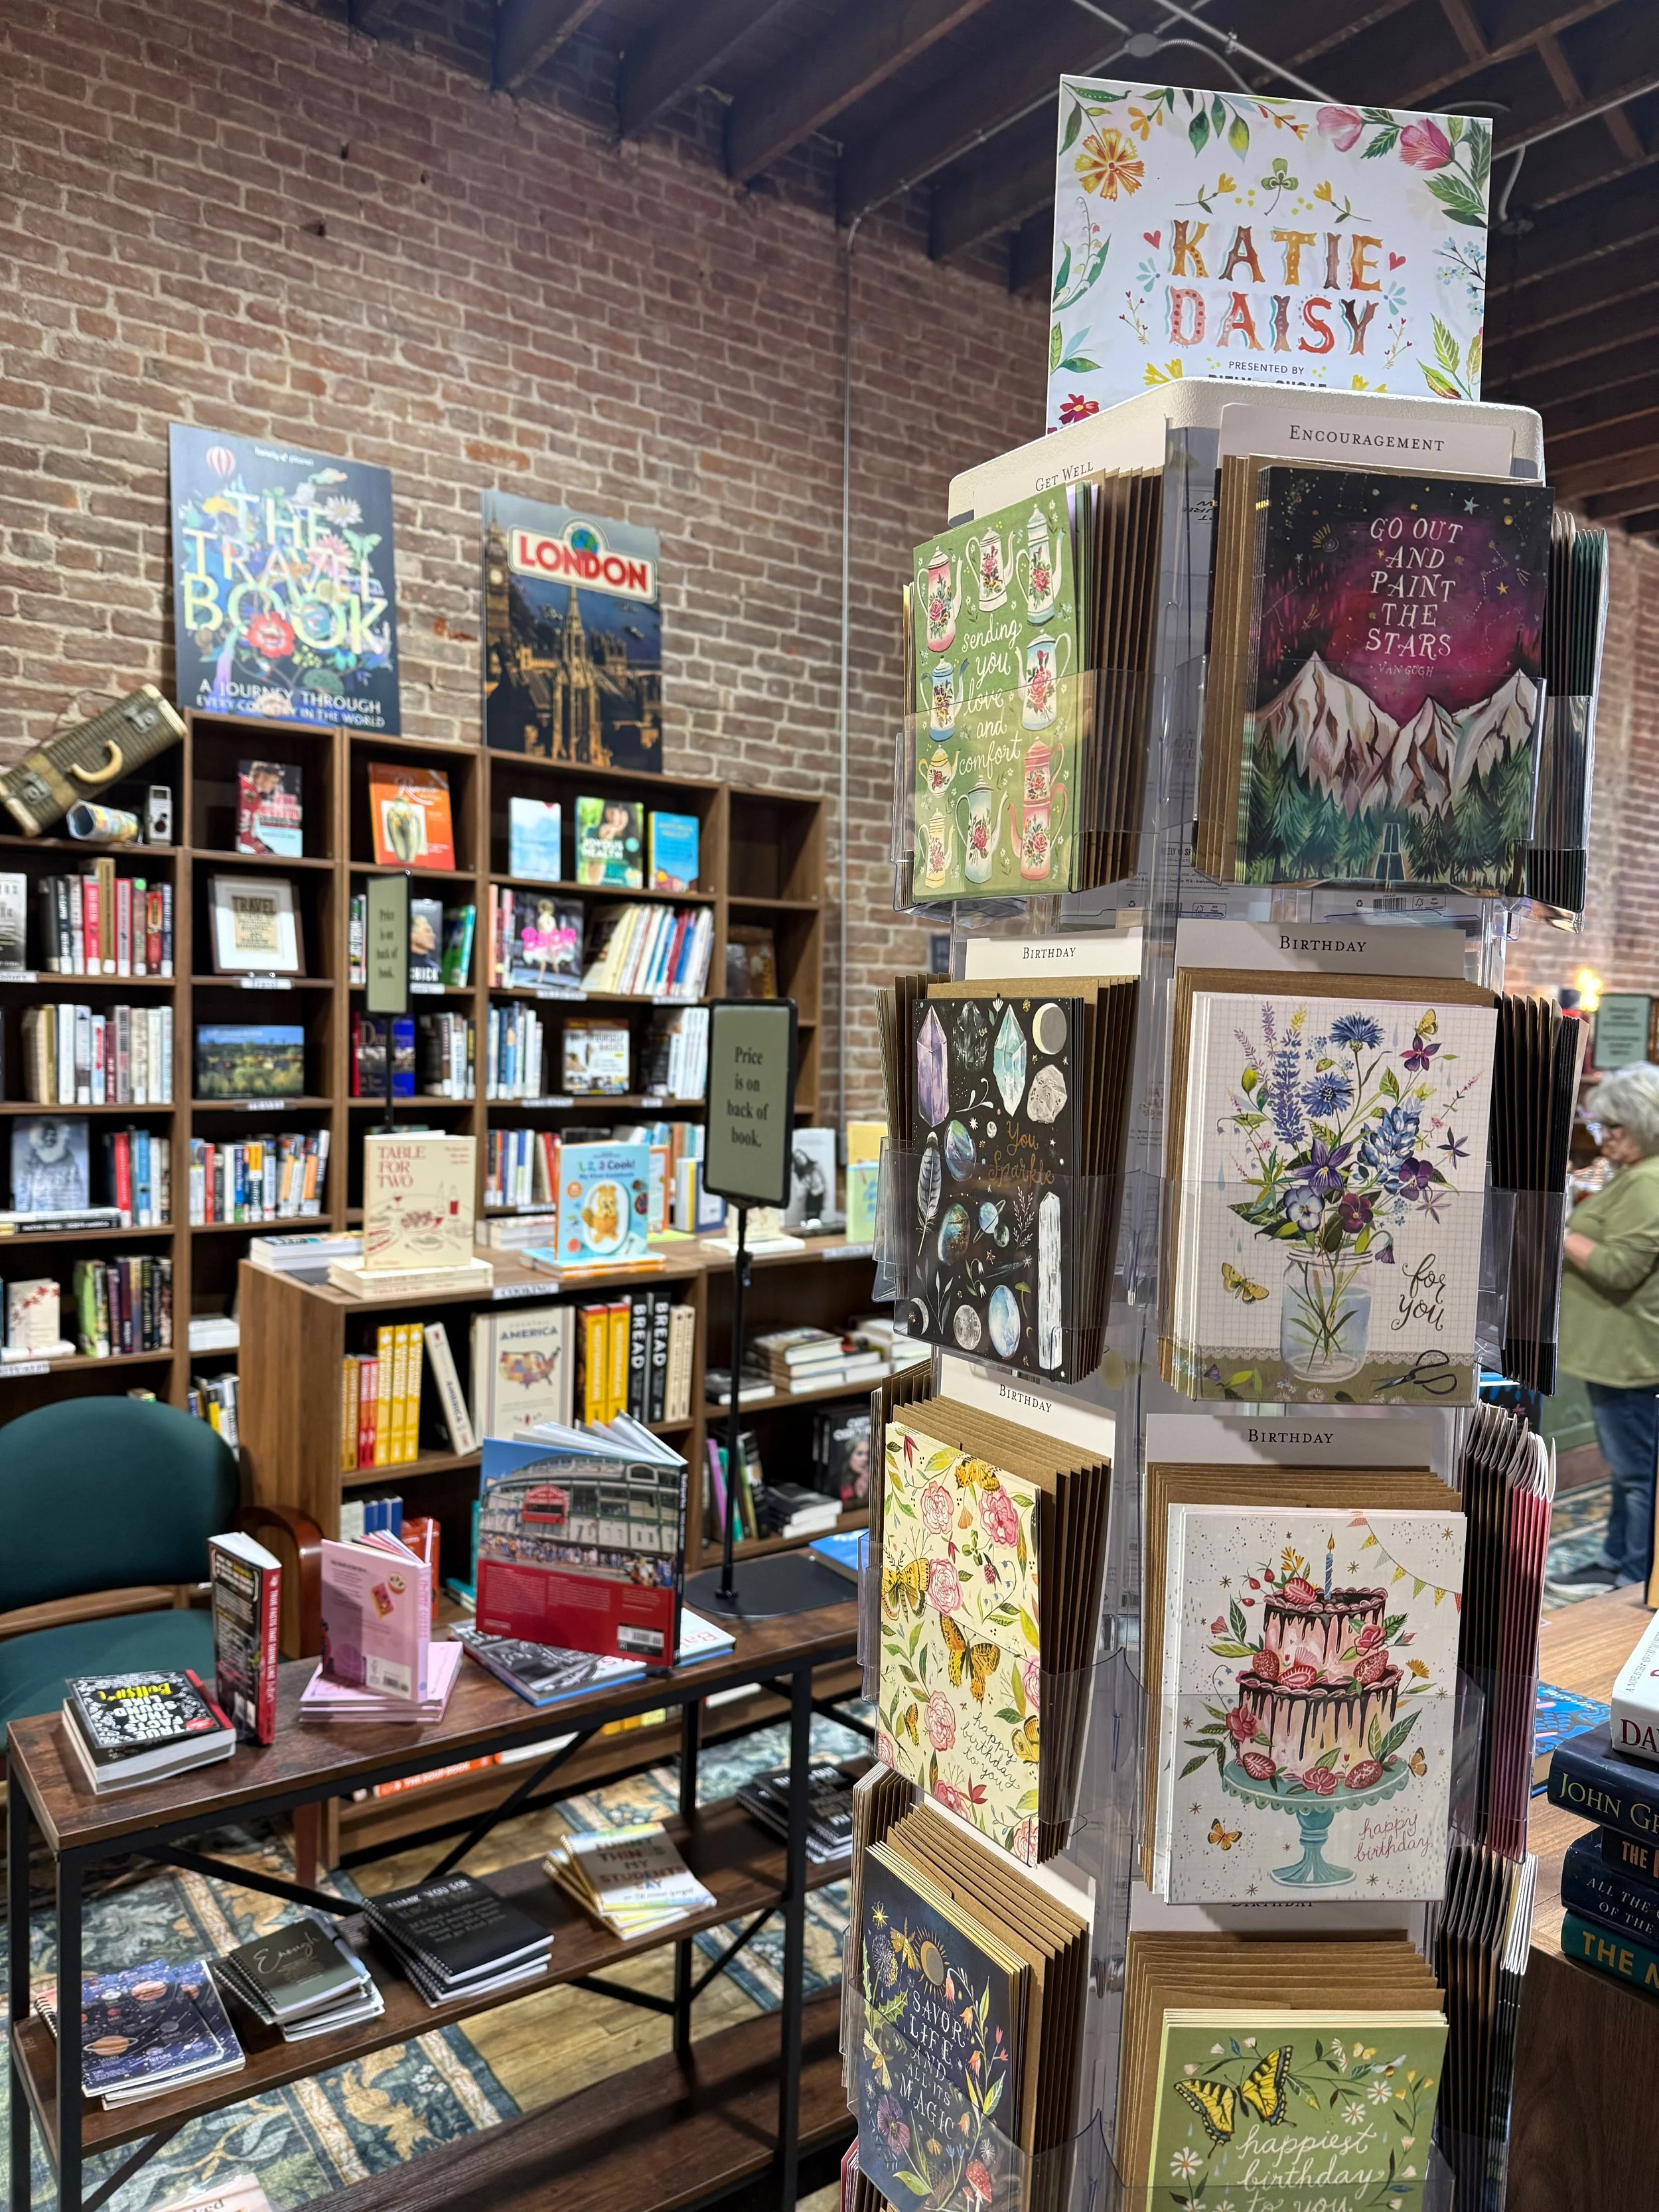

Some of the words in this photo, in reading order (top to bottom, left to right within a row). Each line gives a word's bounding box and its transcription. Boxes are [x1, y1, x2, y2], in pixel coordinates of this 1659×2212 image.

[1168, 218, 1384, 292] KATIE
[1166, 285, 1380, 356] DAISY
[1228, 360, 1288, 374] PRESENTED
[1291, 366, 1305, 375] BY
[1289, 425, 1445, 452] ENCOURAGEMENT
[1035, 475, 1058, 492] GET
[1062, 461, 1094, 481] WELL
[223, 489, 332, 550] THE
[1370, 517, 1403, 540] GO
[1412, 518, 1463, 544] OUT
[182, 528, 372, 599] TRAVEL
[519, 535, 648, 593] LONDON
[1384, 546, 1445, 569] AND
[1370, 570, 1457, 603] PAINT
[183, 572, 389, 656] BOOK
[1382, 603, 1439, 629] THE
[962, 619, 1023, 654] sending
[1365, 628, 1451, 660] STARS
[975, 651, 1011, 677] you
[1378, 663, 1402, 676] VAN
[1404, 664, 1434, 678] GOGH
[200, 678, 212, 694] A
[299, 690, 382, 715] THROUGH
[964, 685, 1004, 717] love
[975, 709, 1007, 739] and
[958, 731, 1023, 781] comfort
[1022, 946, 1076, 960] BIRTHDAY
[1279, 934, 1368, 953] BIRTHDAY
[735, 1047, 764, 1066] Price
[735, 1073, 744, 1090] is
[746, 1078, 761, 1092] on
[727, 1100, 755, 1119] back
[756, 1103, 769, 1122] of
[376, 1145, 426, 1160] TABLE
[731, 1126, 762, 1148] book.
[1006, 1120, 1039, 1156] You
[376, 1174, 414, 1188] TWO
[379, 1160, 411, 1173] FOR
[987, 1149, 1055, 1187] Sparkle
[1402, 1252, 1447, 1304] for
[1390, 1294, 1446, 1331] you
[499, 1326, 559, 1341] AMERICA
[630, 1303, 648, 1369] BREAD
[652, 1301, 670, 1367] BREAD
[999, 1383, 1052, 1414] BIRTHDAY
[1248, 1428, 1334, 1445] BIRTHDAY
[269, 1589, 279, 1606] TRUE
[267, 1643, 277, 1666] SOUND
[113, 1700, 178, 1717] SOUND
[119, 1694, 163, 1708] LIKE
[127, 1709, 174, 1724] THAT
[123, 1715, 184, 1733] FACTS
[133, 1724, 186, 1741] TRUE
[972, 1712, 1018, 1763] happy
[960, 1723, 1020, 1790] birthday
[964, 1744, 977, 1767] to
[977, 1761, 1004, 1792] you
[1559, 1773, 1622, 1818] JOHN
[1360, 1812, 1419, 1842] happy
[1353, 1834, 1433, 1862] birthday
[1622, 1840, 1648, 1870] THE
[422, 1885, 450, 1899] YOU
[1587, 1877, 1613, 1896] ALL
[1621, 1891, 1651, 1914] THE
[1598, 1901, 1619, 1917] OF
[1625, 1912, 1654, 1935] THE
[1582, 1930, 1635, 1976] THE
[911, 1990, 966, 2048] SAVOR
[909, 2016, 954, 2066] LIFE
[910, 2047, 947, 2083] AND
[907, 2061, 929, 2089] ALL
[931, 2080, 952, 2107] ITS
[899, 2076, 956, 2140] MAGIC
[1236, 2122, 1377, 2168] happiest
[1237, 2154, 1386, 2193] birthday
[1245, 2187, 1285, 2212] to
